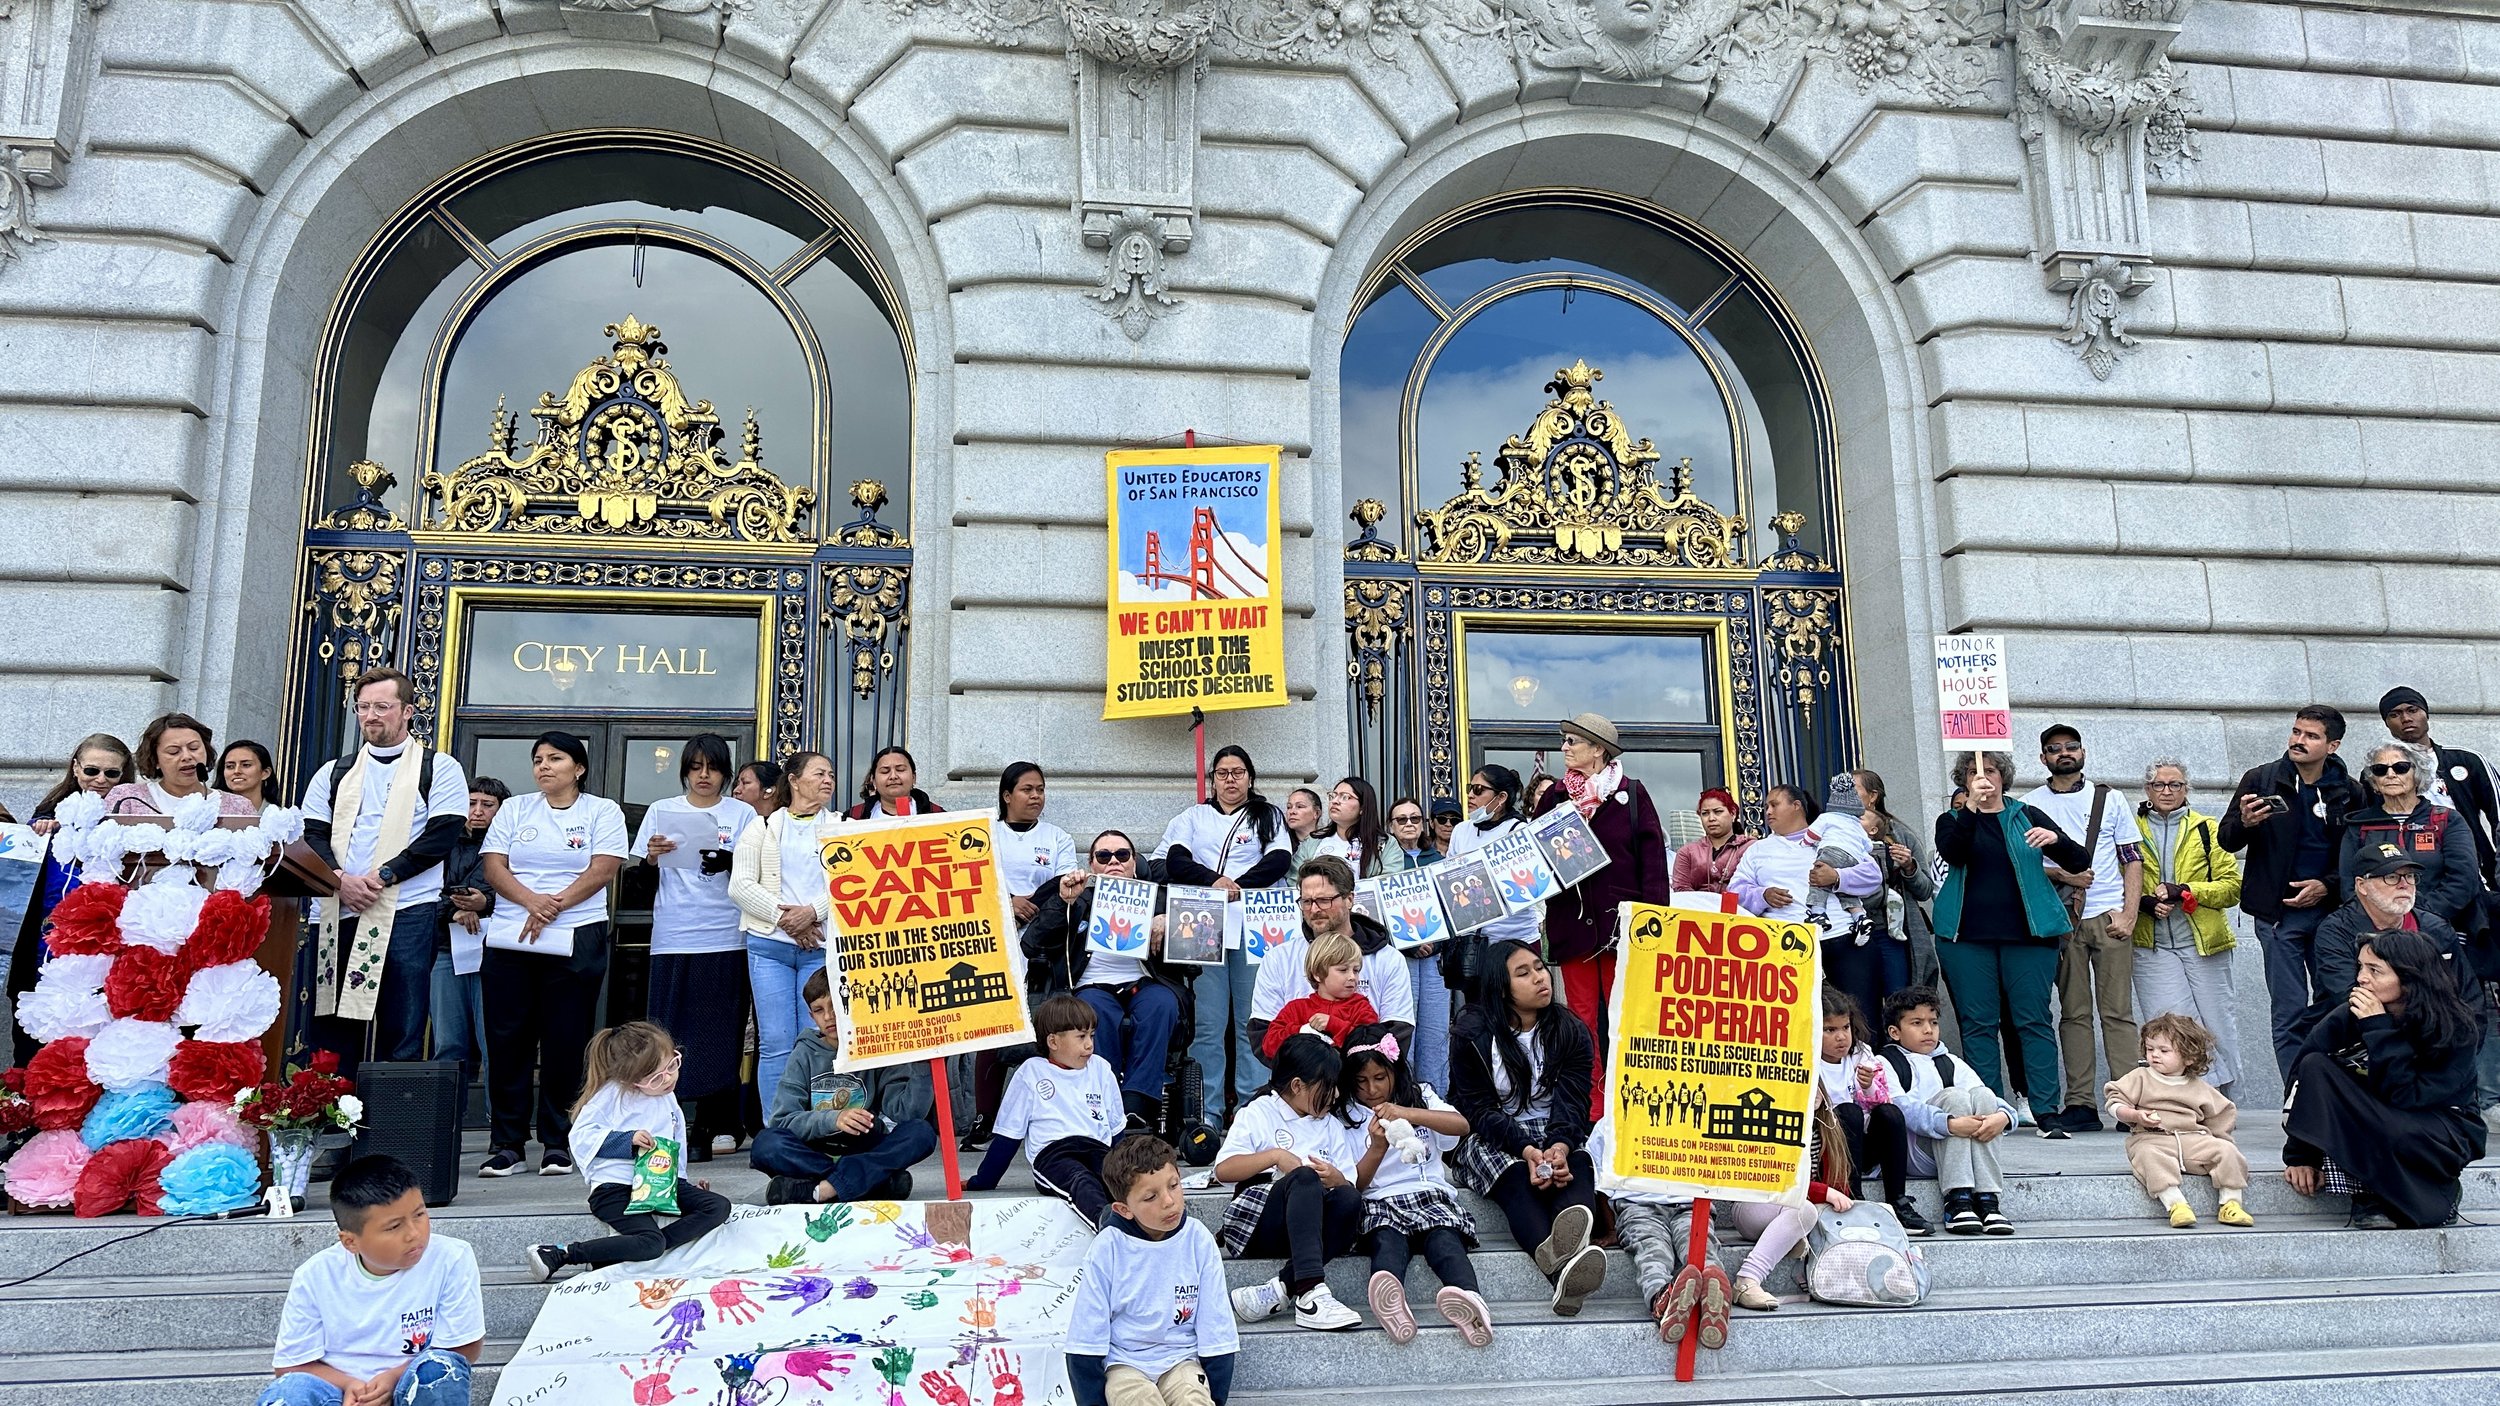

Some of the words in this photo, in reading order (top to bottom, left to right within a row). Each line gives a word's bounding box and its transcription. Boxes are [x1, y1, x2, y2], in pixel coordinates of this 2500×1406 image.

[1124, 471, 1177, 486] UNITED
[1182, 469, 1262, 484] EDUCATORS
[1128, 489, 1146, 501] OF
[1150, 486, 1177, 500] SAN
[1182, 485, 1258, 499] FRANCISCO
[1119, 612, 1149, 636] WE
[1155, 608, 1212, 634] CAN'T
[1218, 605, 1268, 630] WAIT
[1139, 637, 1195, 660] INVEST
[1197, 636, 1214, 656] IN
[1218, 635, 1250, 655] THE
[1938, 637, 1995, 651] HONOR
[513, 641, 605, 674] CITY
[616, 644, 717, 675] HALL
[1139, 656, 1213, 680] SCHOOLS
[1216, 655, 1250, 676] OUR
[1937, 653, 1997, 669] MOTHERS
[1117, 679, 1198, 702] STUDENTS
[1203, 674, 1274, 696] DESERVE
[1943, 676, 1998, 692] HOUSE
[1959, 692, 1990, 707] OUR
[1943, 712, 2007, 735] FAMILIES
[861, 838, 953, 870] WE
[1482, 829, 1529, 860] FAITH
[1489, 857, 1501, 868] IN
[1501, 842, 1533, 863] ACTION
[1493, 863, 1511, 875] BAY
[1510, 851, 1536, 868] AREA
[829, 859, 990, 902] CAN'T
[1099, 879, 1151, 899] FAITH
[1379, 868, 1428, 892] FAITH
[1097, 892, 1110, 901] IN
[1111, 894, 1149, 908] ACTION
[1244, 890, 1294, 905] FAITH
[1382, 891, 1394, 900] IN
[1395, 883, 1430, 897] ACTION
[1385, 899, 1405, 909] BAY
[1405, 893, 1432, 904] AREA
[835, 887, 982, 928] WAIT
[1096, 901, 1117, 911] BAY
[1118, 905, 1147, 916] AREA
[1245, 905, 1257, 914] IN
[1258, 905, 1295, 914] ACTION
[1246, 914, 1265, 922] BAY
[835, 932, 881, 953] INVEST
[885, 930, 900, 948] IN
[903, 927, 928, 945] THE
[931, 919, 991, 942] SCHOOLS
[1676, 920, 1770, 960] NO
[838, 954, 866, 972] OUR
[870, 945, 936, 969] STUDENTS
[940, 936, 998, 959] DESERVE
[1655, 953, 1798, 1005] PODEMOS
[855, 1026, 880, 1036] FULLY
[883, 1023, 906, 1032] STAFF
[908, 1020, 923, 1029] OUR
[926, 1012, 962, 1026] SCHOOLS
[1658, 996, 1790, 1048] ESPERAR
[856, 1033, 890, 1046] IMPROVE
[892, 1027, 932, 1041] EDUCATOR
[934, 1025, 948, 1035] PAY
[857, 1043, 896, 1056] STABILITY
[899, 1040, 914, 1050] FOR
[917, 1033, 955, 1049] STUDENTS
[956, 1032, 961, 1041] &
[963, 1024, 1015, 1040] COMMUNITIES
[1630, 1036, 1678, 1055] INVIERTA
[1681, 1041, 1696, 1056] EN
[1700, 1043, 1721, 1059] LAS
[1723, 1044, 1777, 1064] ESCUELAS
[1781, 1051, 1804, 1067] QUE
[1624, 1052, 1677, 1071] NUESTROS
[1681, 1058, 1751, 1078] ESTUDIANTES
[1756, 1065, 1809, 1084] MERECEN
[1641, 1136, 1679, 1148] ESCUELAS
[1681, 1139, 1697, 1150] CON
[1699, 1141, 1735, 1153] PERSONAL
[1737, 1143, 1776, 1156] COMPLETO
[1642, 1150, 1687, 1163] ESTABILIDAD
[1689, 1154, 1708, 1165] PARA
[1642, 1164, 1670, 1175] SUELDO
[1672, 1167, 1696, 1178] JUSTO
[1698, 1169, 1716, 1179] PARA
[1717, 1169, 1731, 1180] LOS
[1174, 1284, 1199, 1295] FAITH
[401, 1306, 433, 1323] FAITH
[410, 1316, 433, 1328] ACTION
[527, 1336, 593, 1356] Juanes
